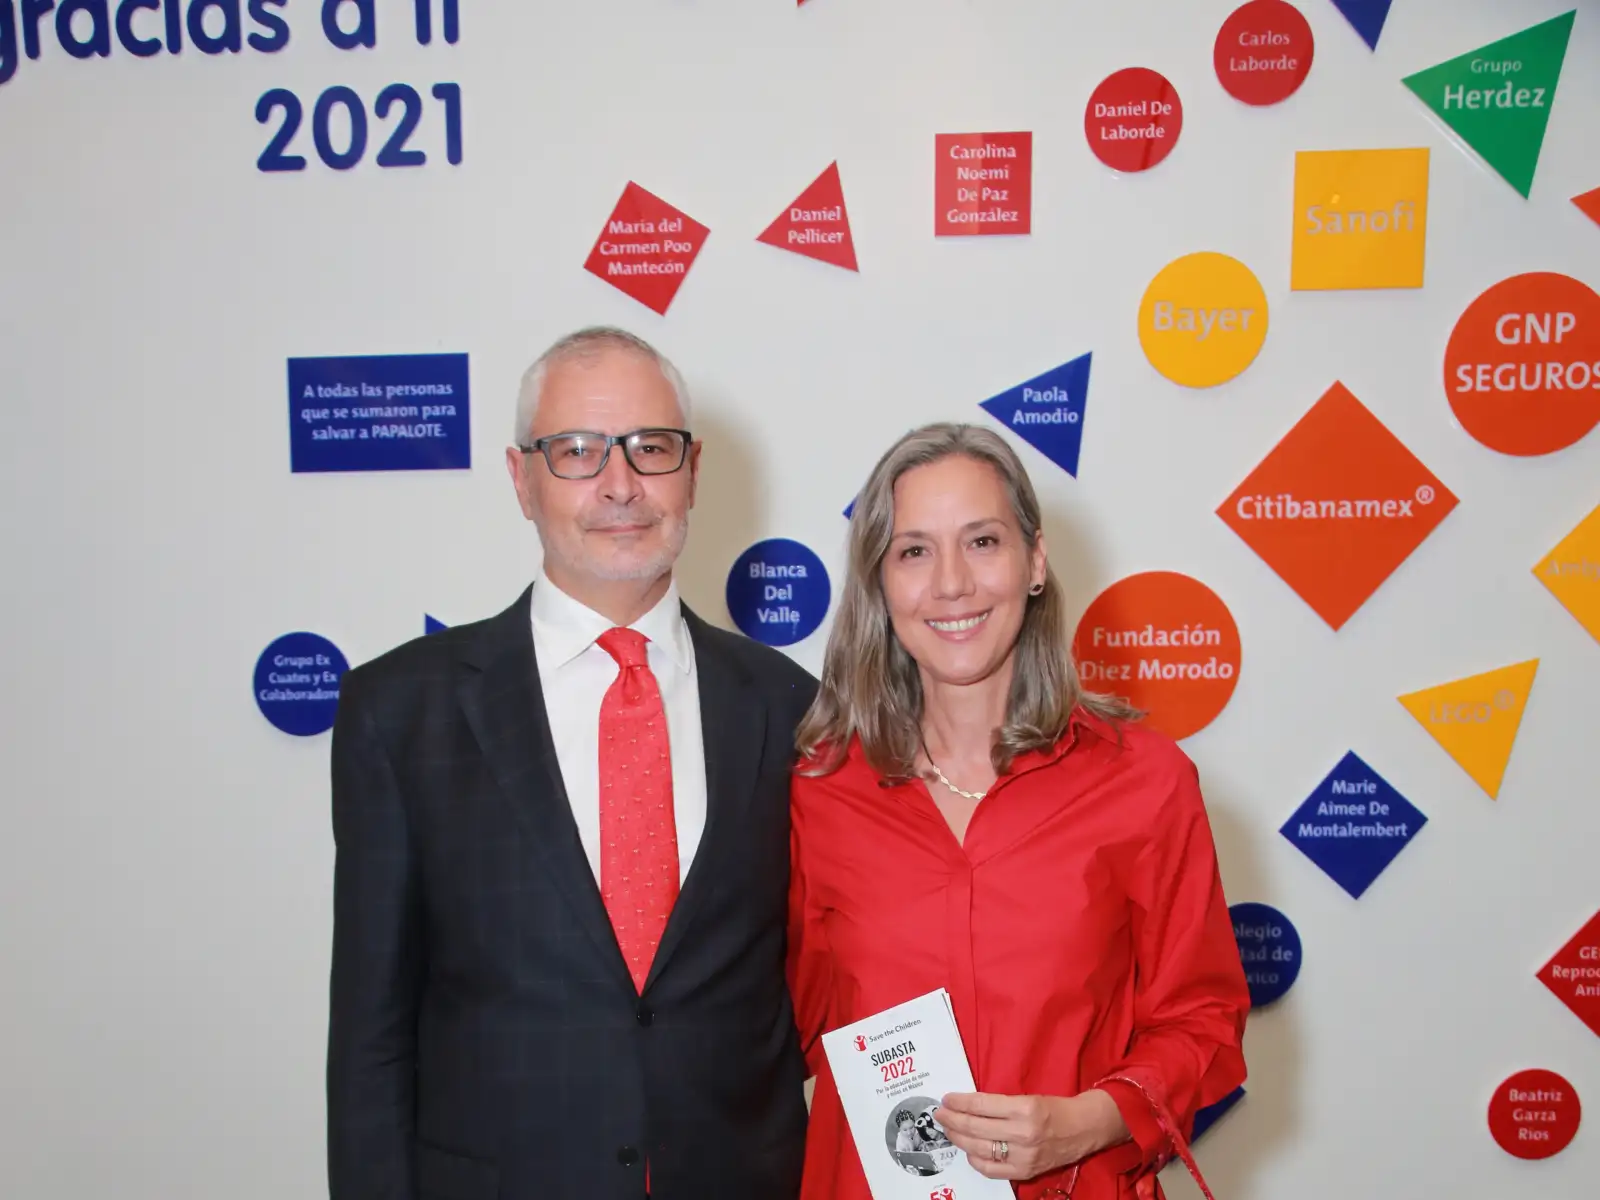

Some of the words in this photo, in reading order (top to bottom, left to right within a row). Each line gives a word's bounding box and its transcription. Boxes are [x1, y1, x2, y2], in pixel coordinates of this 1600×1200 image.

[320, 0, 376, 50] a
[1238, 31, 1290, 47] Carlos
[1229, 55, 1298, 72] Laborde
[1470, 58, 1523, 76] Grupo
[1443, 80, 1546, 110] Herdez
[1094, 101, 1147, 118] Daniel
[1150, 101, 1172, 116] De
[254, 82, 463, 172] 2021
[1100, 123, 1166, 141] Laborde
[949, 143, 1017, 160] Carolina
[957, 187, 978, 202] De
[981, 186, 1009, 201] Paz
[790, 205, 842, 222] Daniel
[946, 207, 1019, 223] González
[1305, 200, 1416, 236] Sanofi
[657, 217, 682, 233] del
[787, 228, 845, 245] Pellicer
[600, 241, 660, 256] Carmen
[663, 239, 692, 254] Poo
[607, 259, 685, 277] Mantecón
[1152, 300, 1255, 343] Bayer
[1494, 311, 1577, 346] GNP
[303, 384, 315, 398] A
[316, 382, 359, 398] todas
[361, 382, 383, 397] las
[386, 383, 454, 400] personas
[1023, 386, 1069, 403] Paola
[301, 407, 330, 424] que
[332, 407, 349, 419] se
[351, 405, 419, 419] sumaron
[421, 404, 457, 421] para
[1012, 407, 1079, 425] Amodio
[312, 425, 357, 441] salvar
[358, 428, 369, 439] a
[371, 422, 447, 439] PAPALOTE.
[749, 560, 808, 579] Blanca
[764, 583, 793, 601] Del
[756, 606, 801, 623] Valle
[1093, 624, 1221, 647] Fundación
[273, 654, 315, 669] Grupo
[315, 653, 331, 666] Ex
[1079, 660, 1132, 681] Diez
[1137, 656, 1234, 680] Morodo
[312, 672, 321, 686] y
[322, 670, 338, 684] Ex
[260, 687, 340, 701] Colaborador
[1331, 779, 1377, 795] Marie
[1317, 800, 1366, 816] Aimee
[1368, 800, 1390, 816] De
[1298, 821, 1408, 838] Montalembert
[1233, 922, 1283, 943] legio
[1271, 946, 1294, 961] de
[1579, 945, 1600, 960] GE
[869, 1032, 884, 1043] Save
[884, 1028, 895, 1037] the
[894, 1018, 923, 1033] Children
[870, 1040, 917, 1067] SUBASTA
[880, 1056, 917, 1083] 2022
[1508, 1087, 1562, 1103] Beatriz
[1512, 1107, 1557, 1122] Garza
